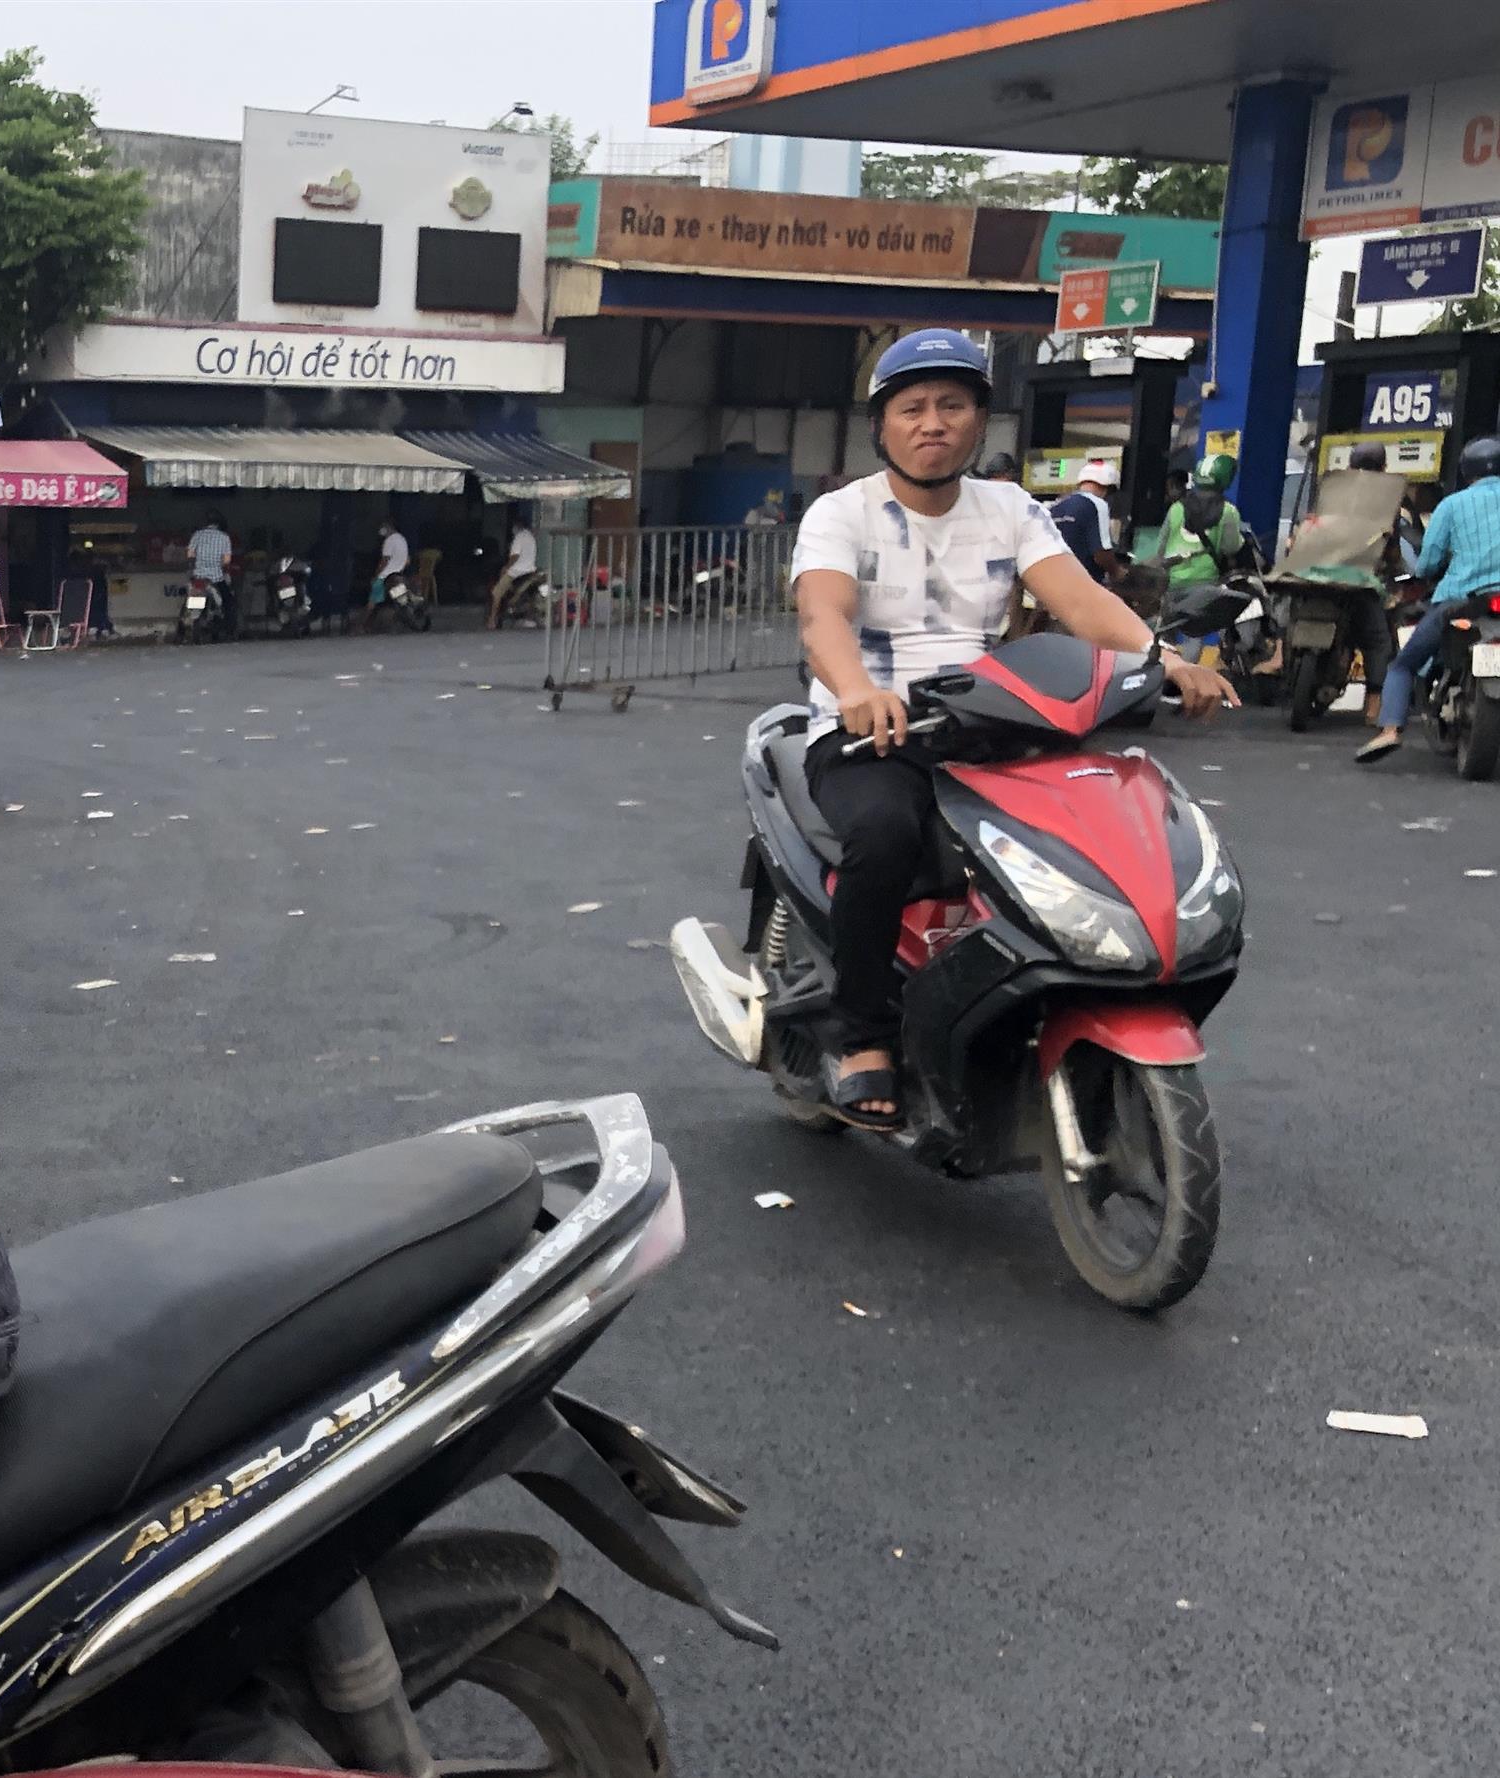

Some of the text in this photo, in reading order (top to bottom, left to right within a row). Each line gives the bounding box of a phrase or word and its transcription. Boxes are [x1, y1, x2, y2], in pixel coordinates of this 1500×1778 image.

[674, 217, 701, 239] xe
[722, 214, 771, 249] thay
[195, 336, 457, 382] Cơ hội để tốt hơn
[1369, 384, 1433, 424] A95
